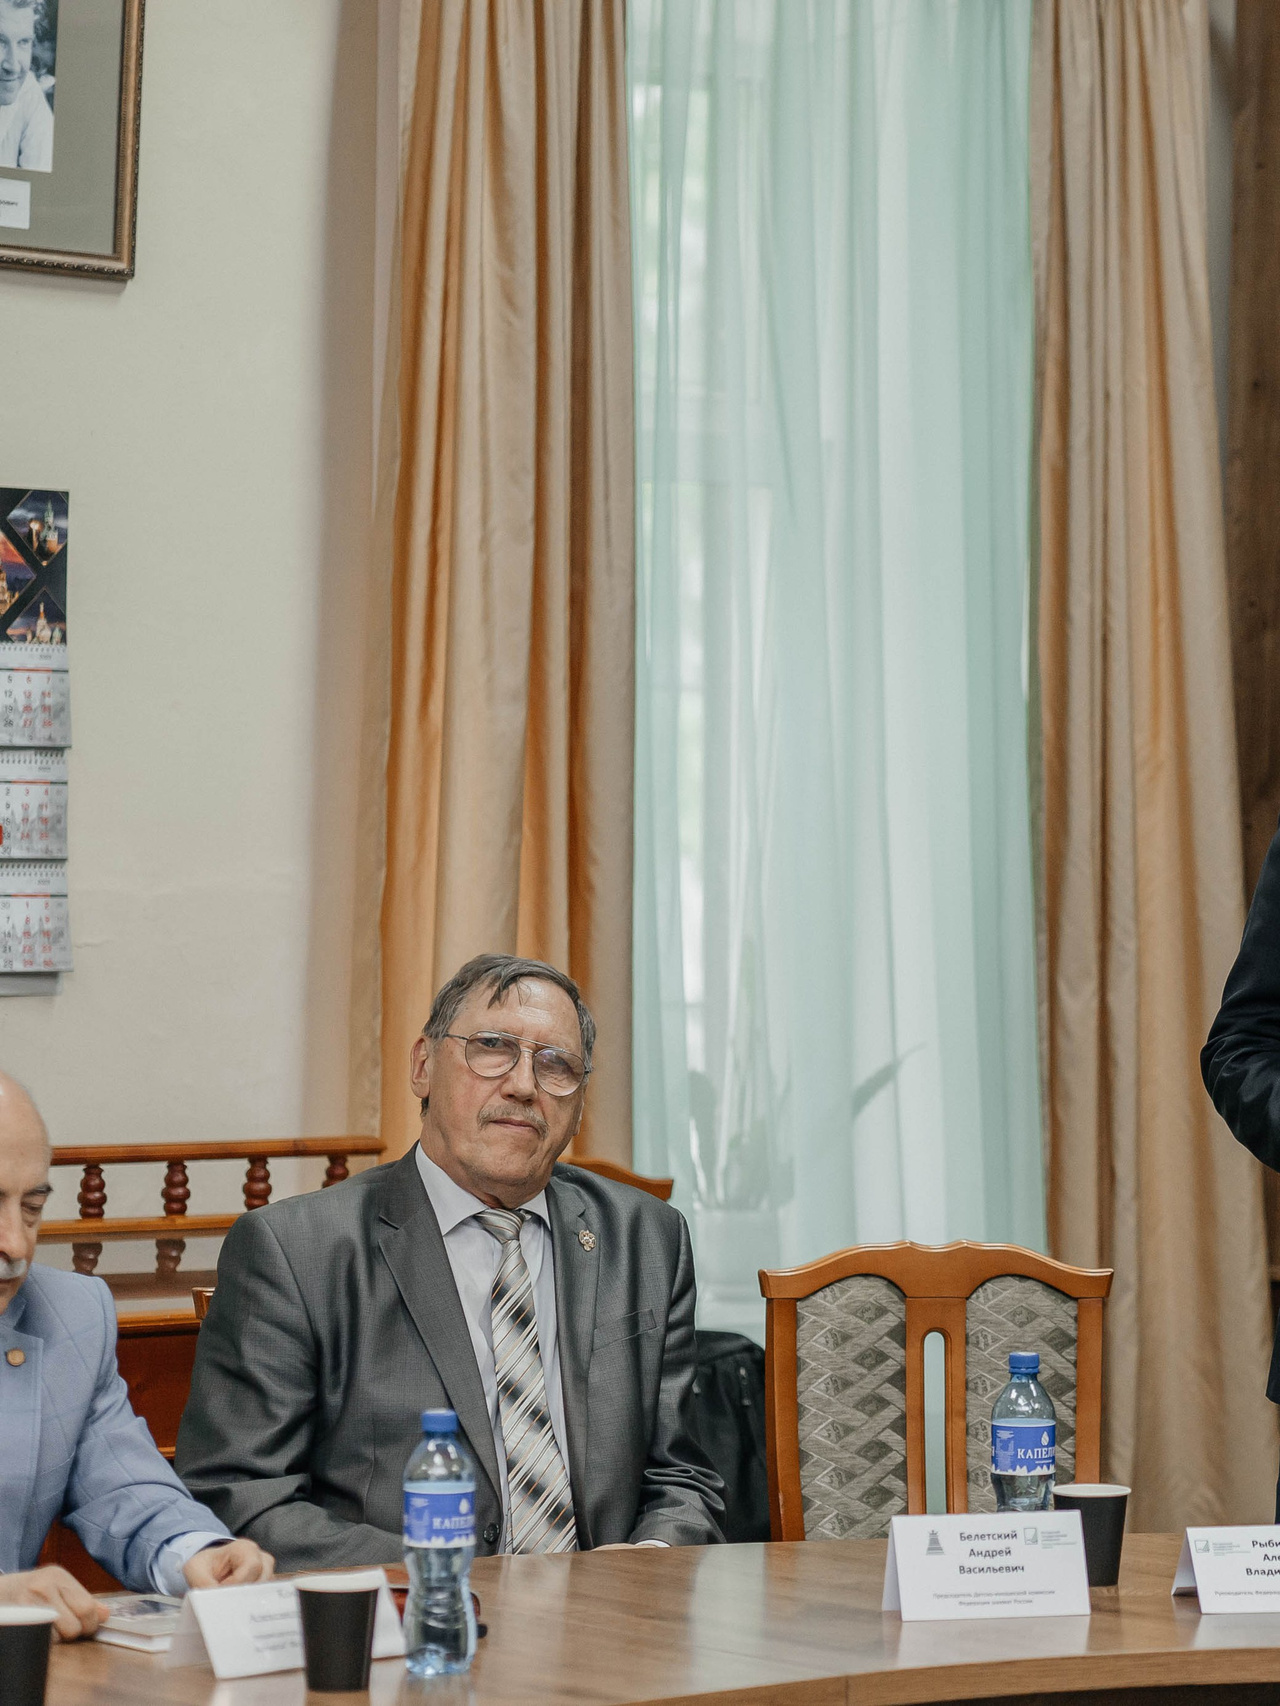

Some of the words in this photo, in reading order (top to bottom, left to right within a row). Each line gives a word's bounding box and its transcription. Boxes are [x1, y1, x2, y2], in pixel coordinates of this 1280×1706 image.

[959, 1530, 1018, 1541] Белетский
[968, 1548, 1012, 1559] Андрей
[958, 1565, 1024, 1575] Васильевич
